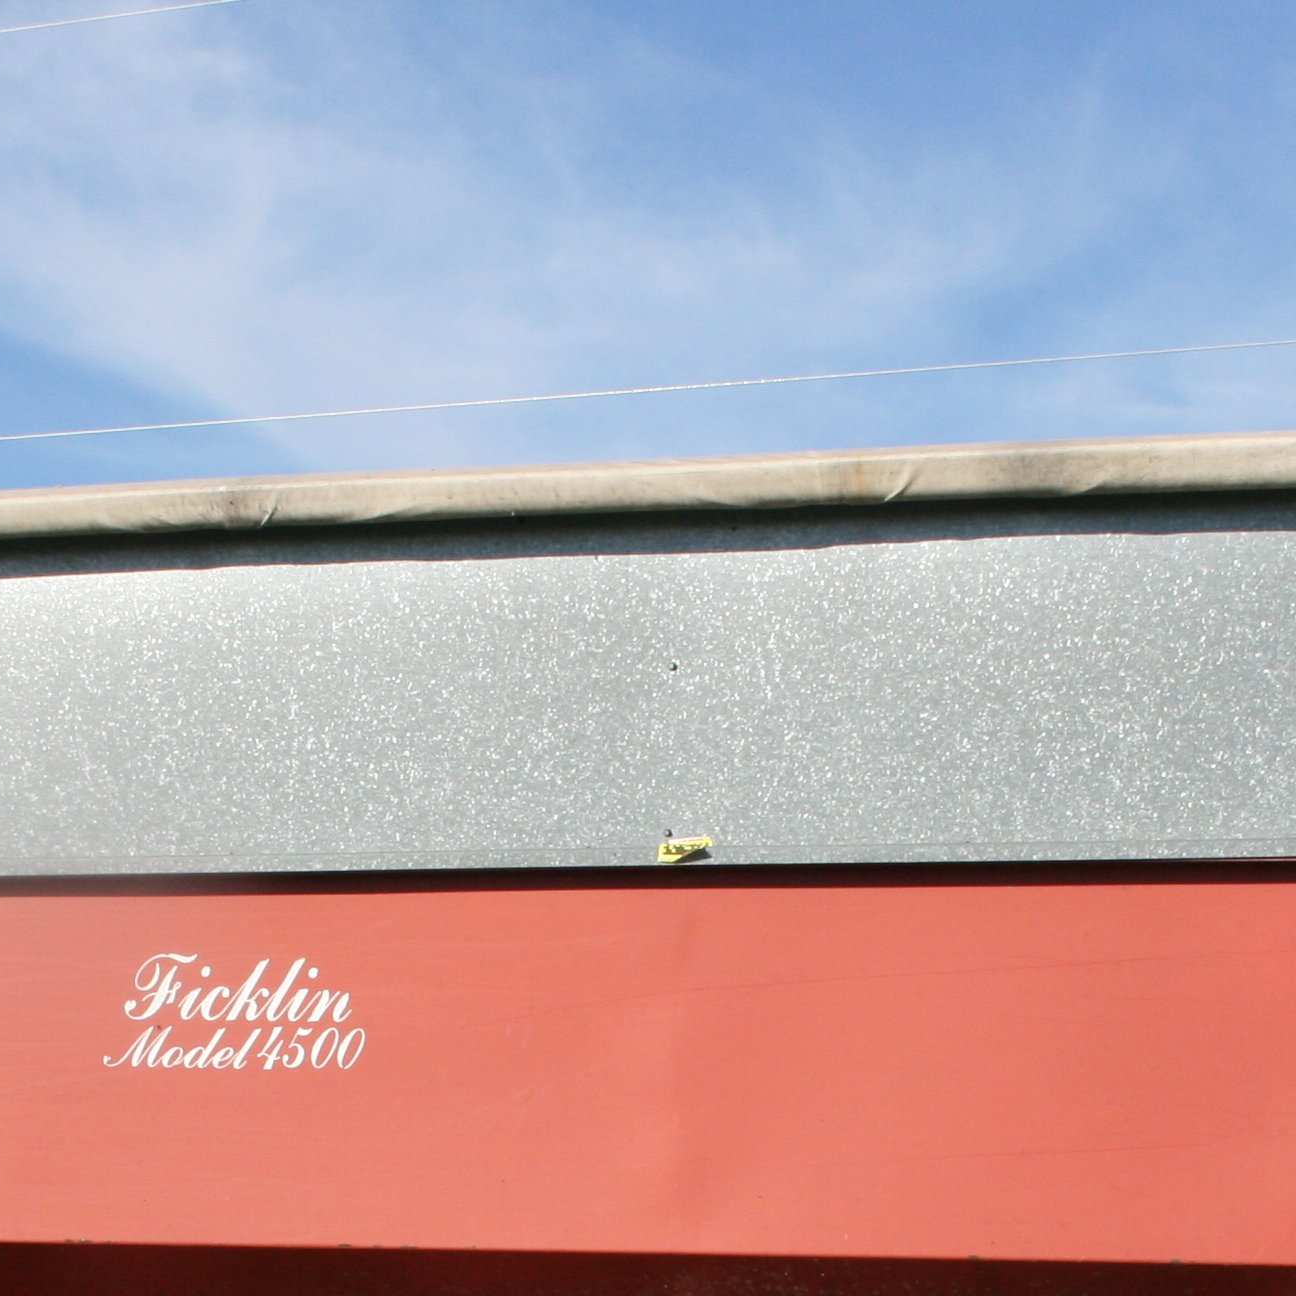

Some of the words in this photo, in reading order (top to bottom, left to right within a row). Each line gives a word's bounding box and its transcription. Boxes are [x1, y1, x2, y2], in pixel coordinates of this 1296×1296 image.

[124, 953, 352, 1021] Ficklin
[103, 1025, 262, 1070] Model
[257, 1025, 366, 1070] 4500
